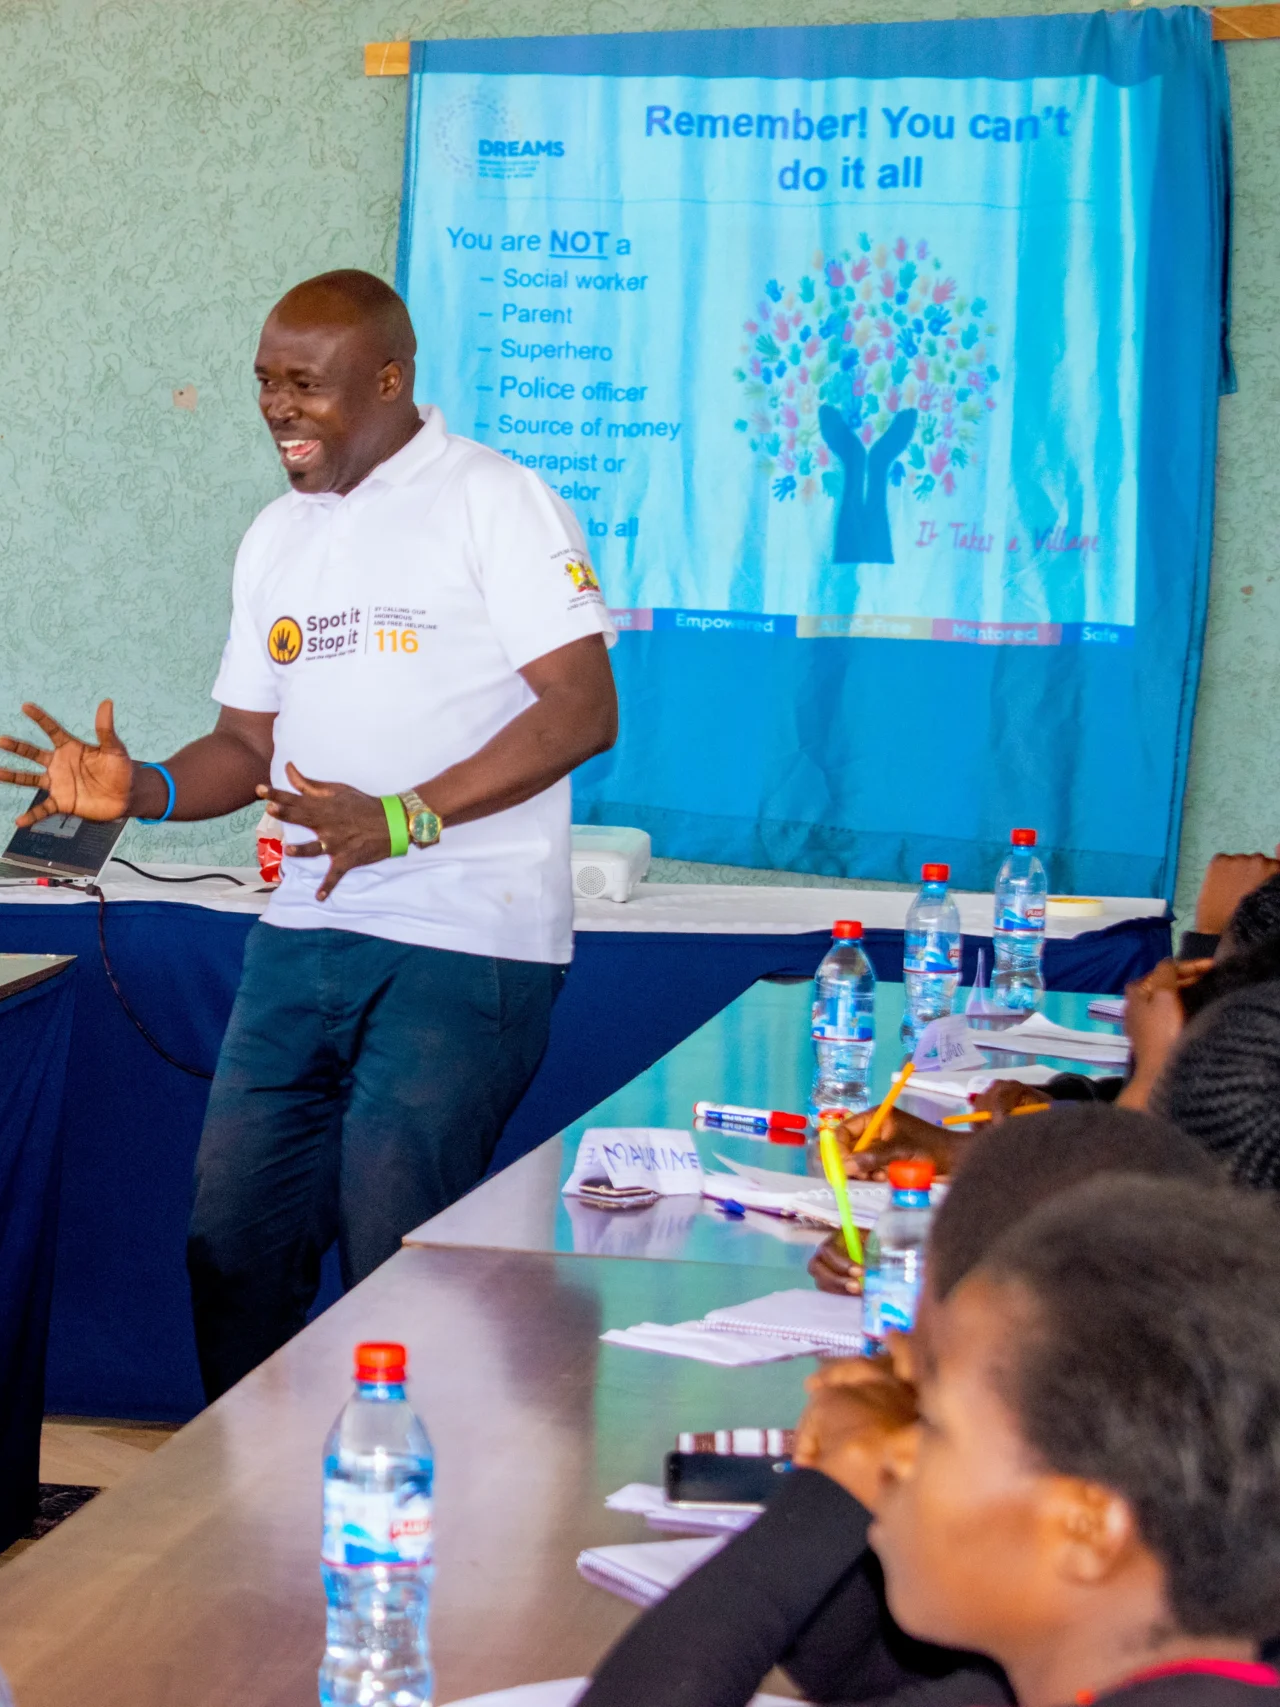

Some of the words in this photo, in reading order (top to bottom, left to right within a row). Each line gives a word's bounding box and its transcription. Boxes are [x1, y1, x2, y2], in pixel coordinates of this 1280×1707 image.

[645, 104, 868, 140] Remember!
[882, 106, 955, 140] You
[968, 105, 1071, 143] can't
[478, 139, 565, 157] DREAMS
[778, 158, 828, 191] do
[841, 156, 866, 189] it
[877, 156, 924, 189] all
[447, 226, 493, 250] You
[501, 233, 542, 251] are
[549, 229, 611, 256] NOT
[615, 238, 632, 256] a
[503, 268, 569, 289] Social
[576, 272, 649, 291] worker
[502, 303, 573, 325] Parent
[500, 338, 614, 362] Superhero
[500, 376, 576, 400] Police
[582, 382, 649, 402] officer
[498, 415, 574, 436] Source
[581, 417, 604, 437] of
[608, 421, 682, 442] money
[603, 457, 626, 474] or
[587, 518, 609, 537] to
[614, 517, 640, 537] all
[915, 520, 939, 548] It
[949, 522, 994, 552] Takes
[1008, 535, 1020, 551] a
[1035, 526, 1100, 562] Village
[306, 611, 347, 634] Spot
[350, 607, 361, 624] it
[675, 612, 775, 633] Empowered
[951, 623, 1039, 642] Mentored
[1081, 626, 1119, 644] Safe
[306, 635, 345, 653] Stop
[347, 628, 358, 645] it
[373, 628, 419, 654] 116
[602, 1142, 699, 1173] MAURINE
